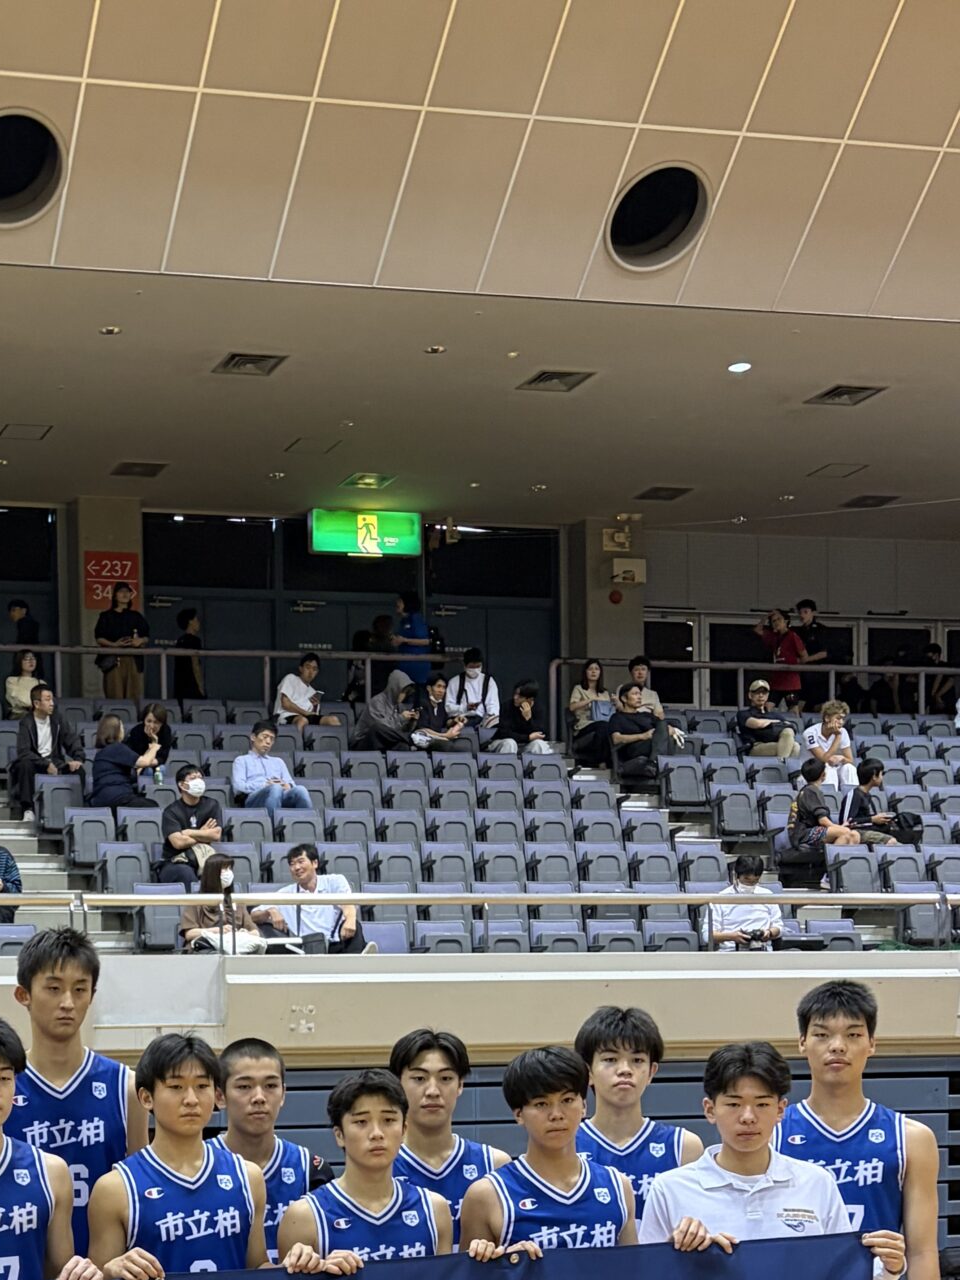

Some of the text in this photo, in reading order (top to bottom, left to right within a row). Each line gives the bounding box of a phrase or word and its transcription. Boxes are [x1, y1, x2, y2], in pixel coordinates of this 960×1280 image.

[101, 560, 132, 577] 237
[93, 583, 113, 600] 34
[22, 1117, 105, 1149] 市立柏
[68, 1163, 90, 1208] 6
[155, 1206, 241, 1242] 市立柏
